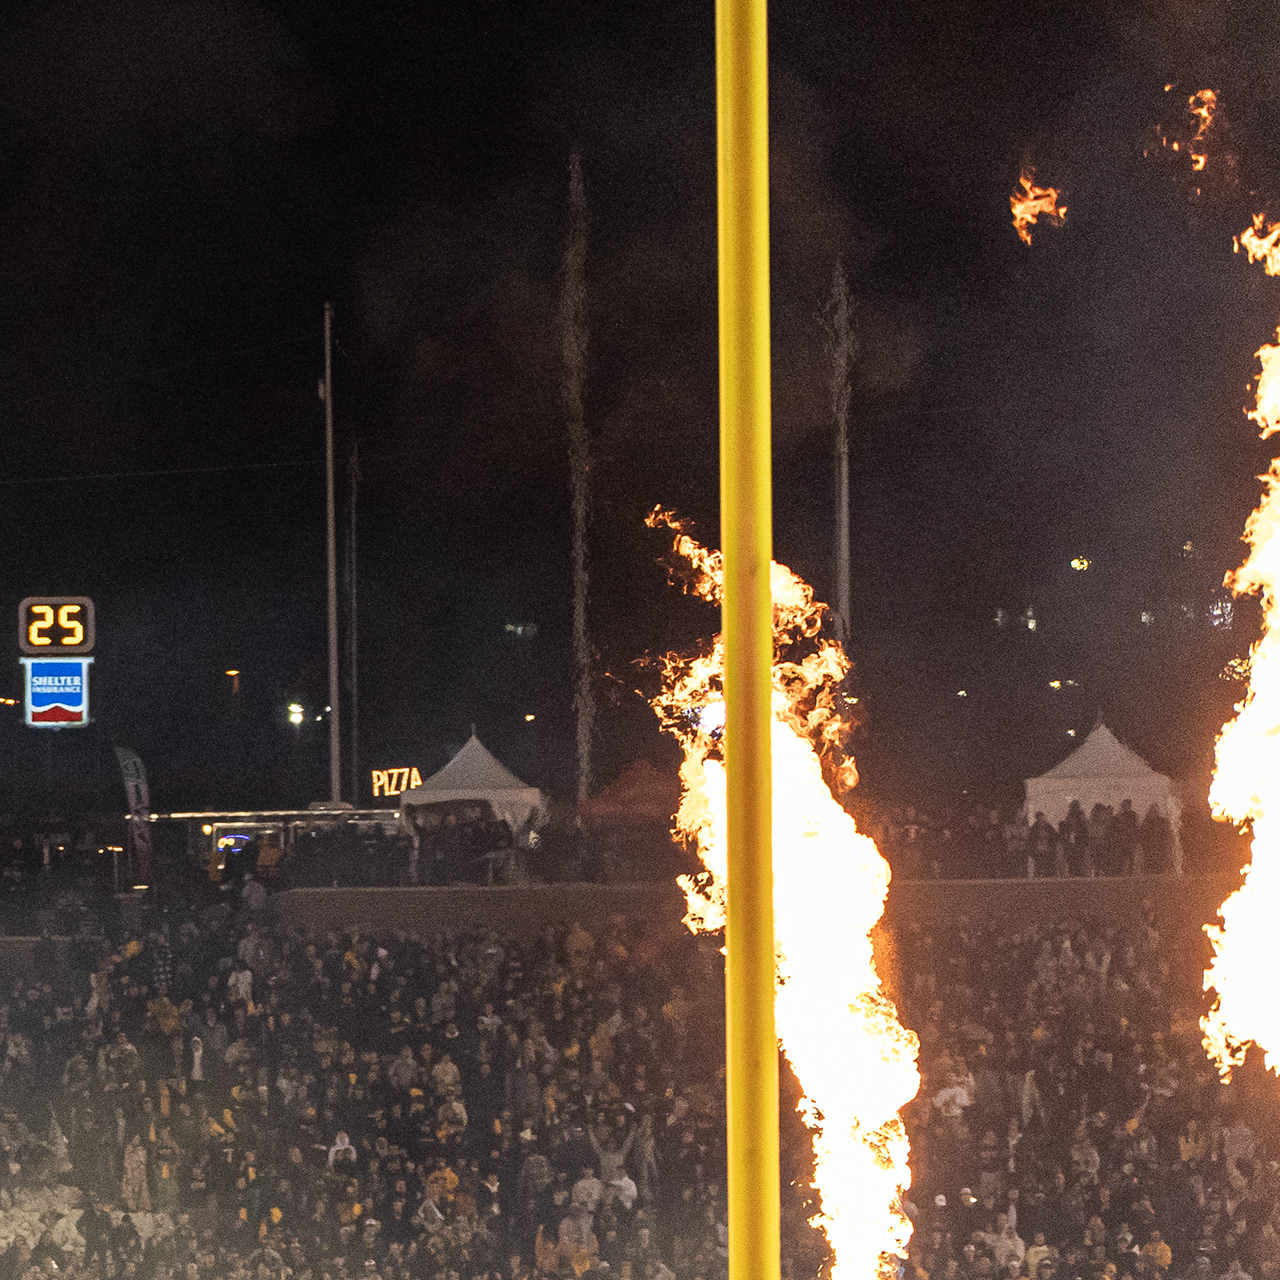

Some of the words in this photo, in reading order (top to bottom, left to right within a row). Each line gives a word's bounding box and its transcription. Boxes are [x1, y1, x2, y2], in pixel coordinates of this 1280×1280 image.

[28, 605, 83, 645] 25
[32, 676, 81, 686] SHELTER
[371, 766, 423, 797] PIZZA
